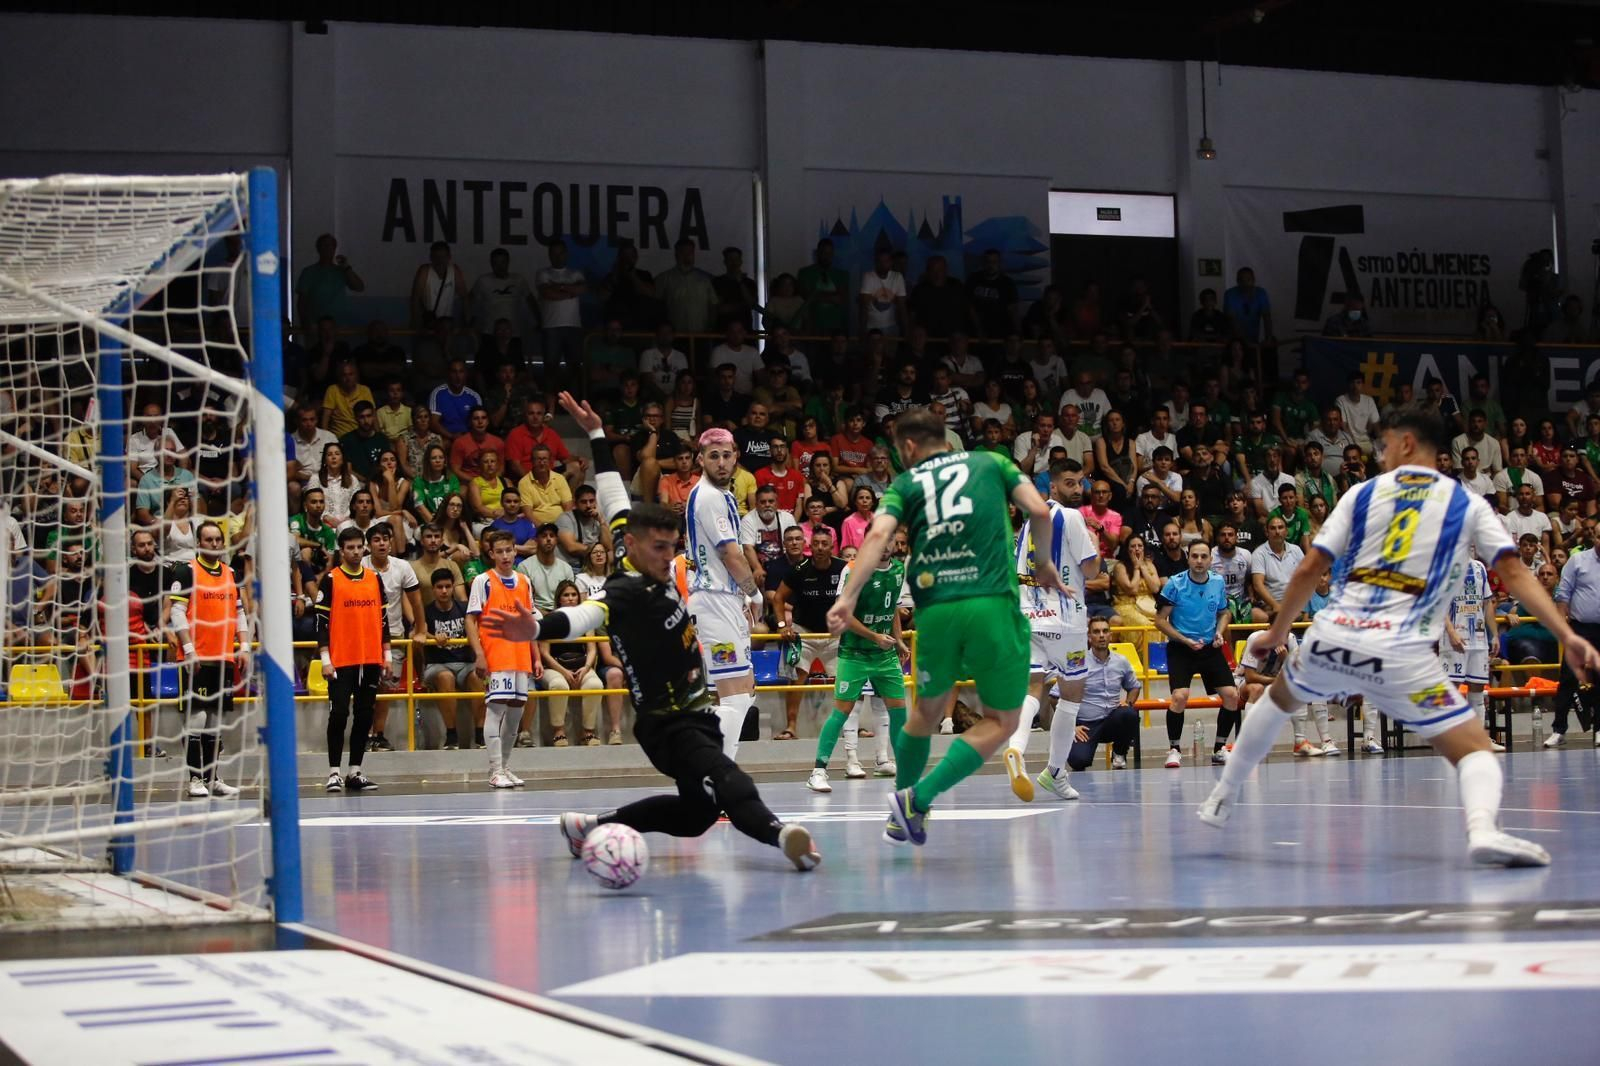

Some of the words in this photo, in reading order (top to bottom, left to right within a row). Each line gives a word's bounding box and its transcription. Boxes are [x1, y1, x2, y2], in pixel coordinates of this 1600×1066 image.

[382, 178, 709, 251] ANTEQUERA
[1371, 277, 1492, 310] ANTEQUERA
[912, 463, 973, 527] 12
[1383, 507, 1421, 564] 8
[343, 599, 376, 608] uhlsport
[884, 591, 892, 609] 8
[1310, 640, 1383, 673] KIA
[1453, 662, 1463, 674] 12
[502, 678, 513, 690] 16
